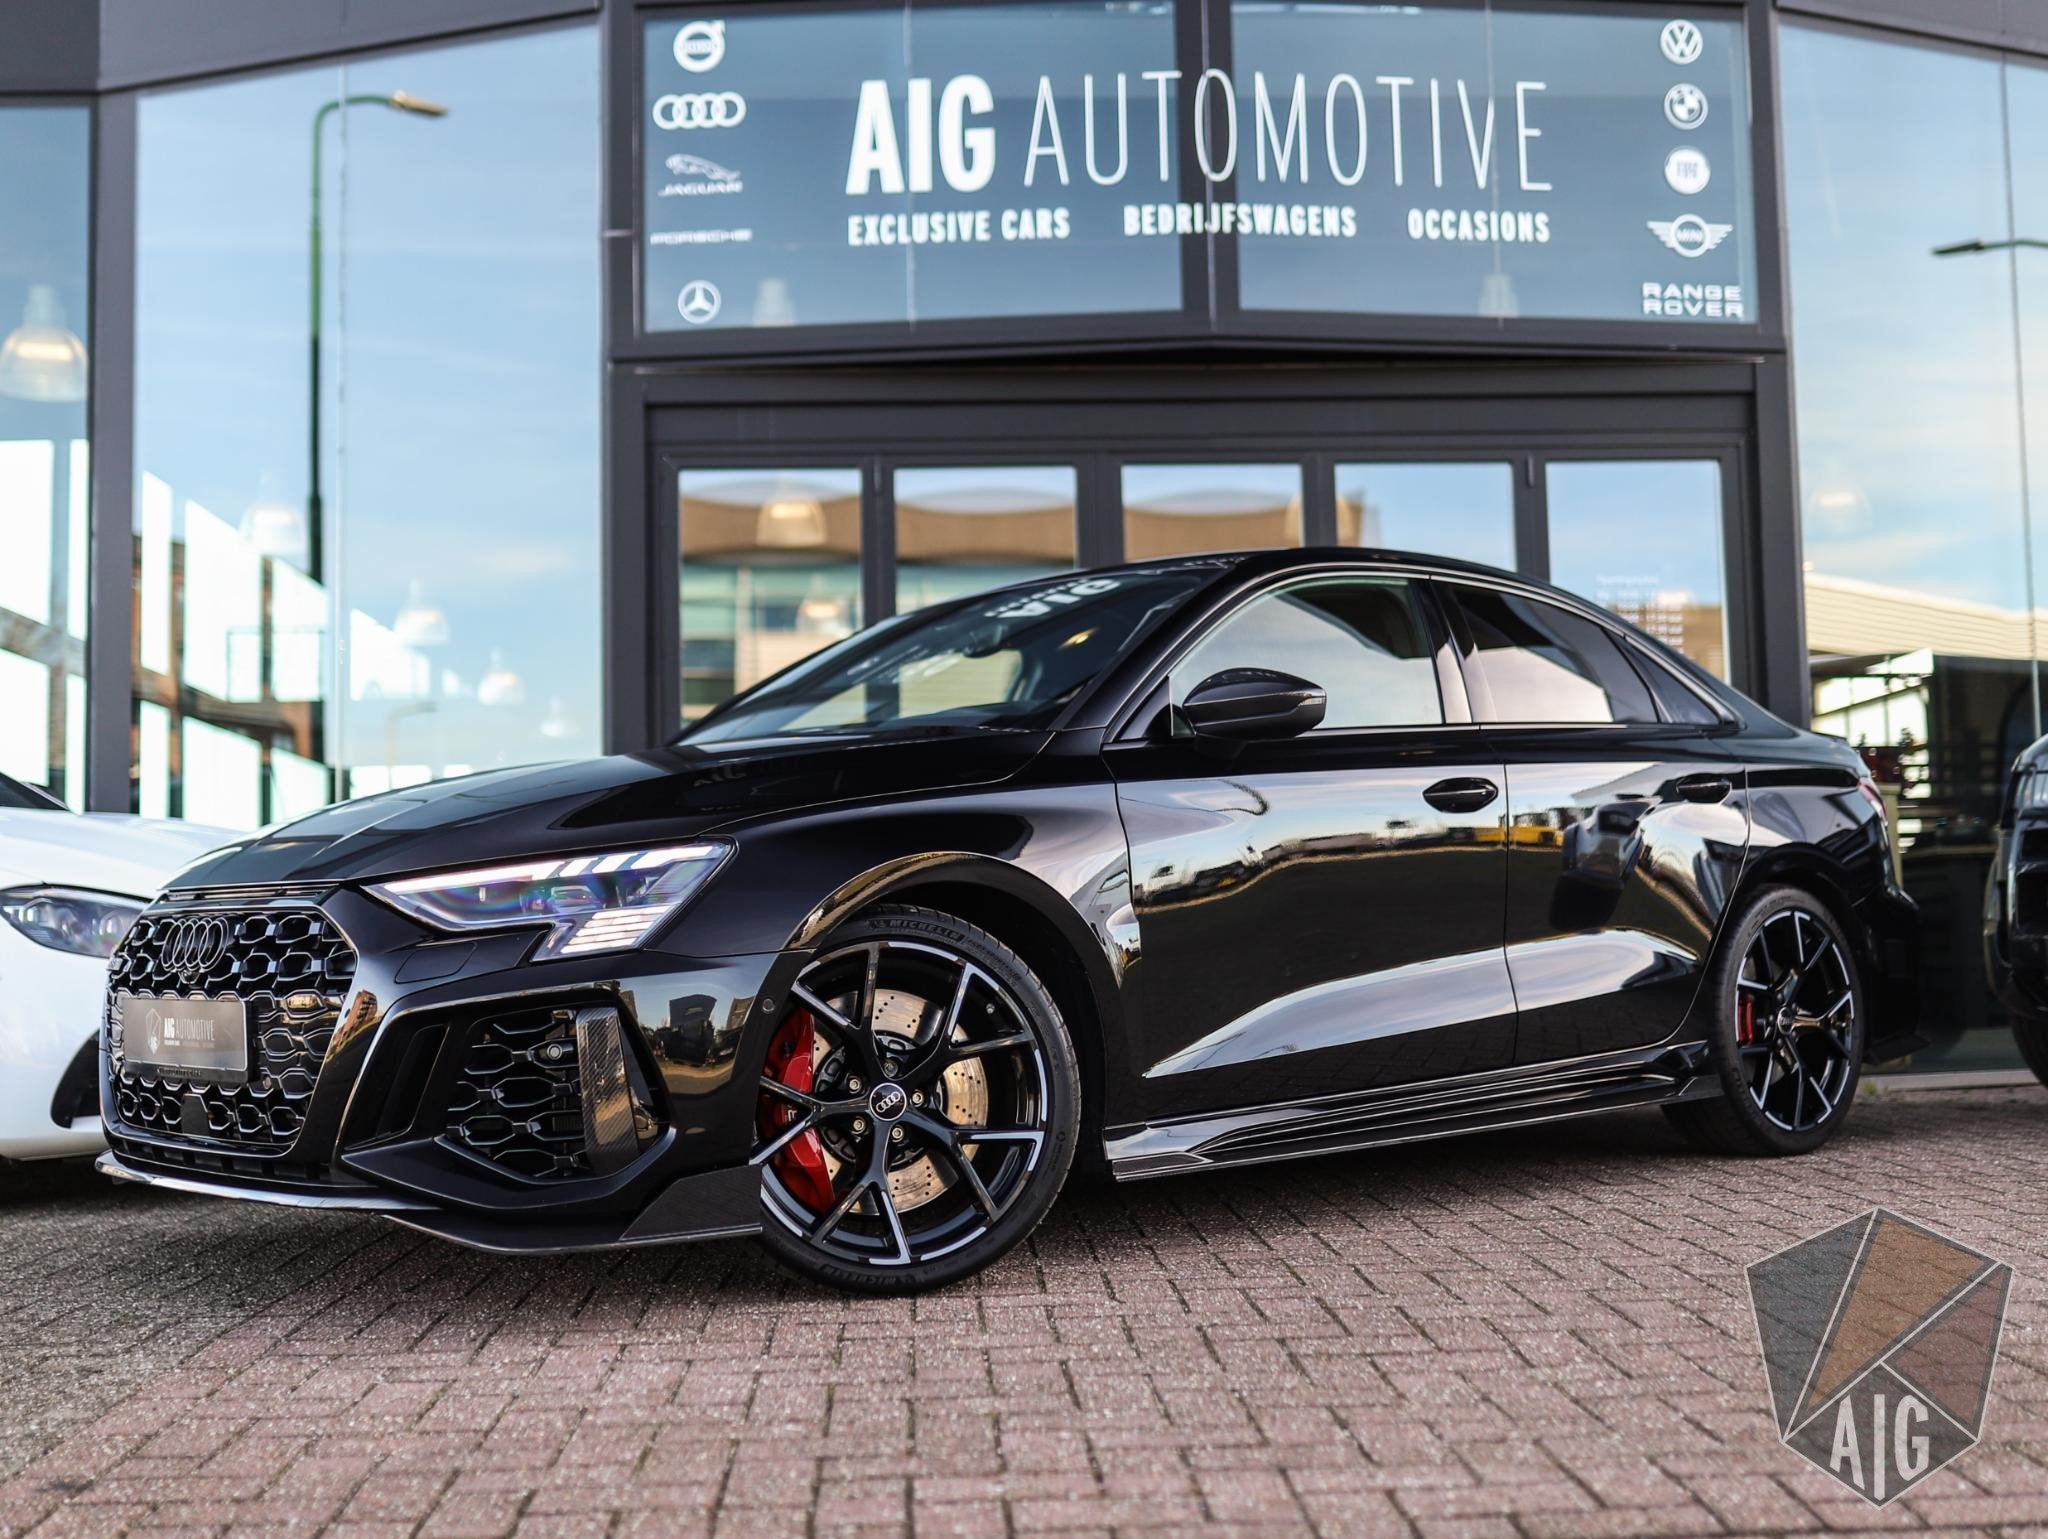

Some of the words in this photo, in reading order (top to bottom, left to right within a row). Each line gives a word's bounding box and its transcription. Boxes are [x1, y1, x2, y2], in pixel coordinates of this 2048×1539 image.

[845, 74, 996, 195] AIG
[1023, 68, 1553, 192] AUTOMOTIVE
[847, 210, 991, 246] EXCLUSIVE
[1001, 207, 1071, 241] CARS
[1123, 203, 1357, 238] BEDRIJFSWAGENS
[1408, 208, 1551, 243] OCCASIONS
[1642, 282, 1741, 300] RANGE
[1643, 299, 1744, 318] ROVER
